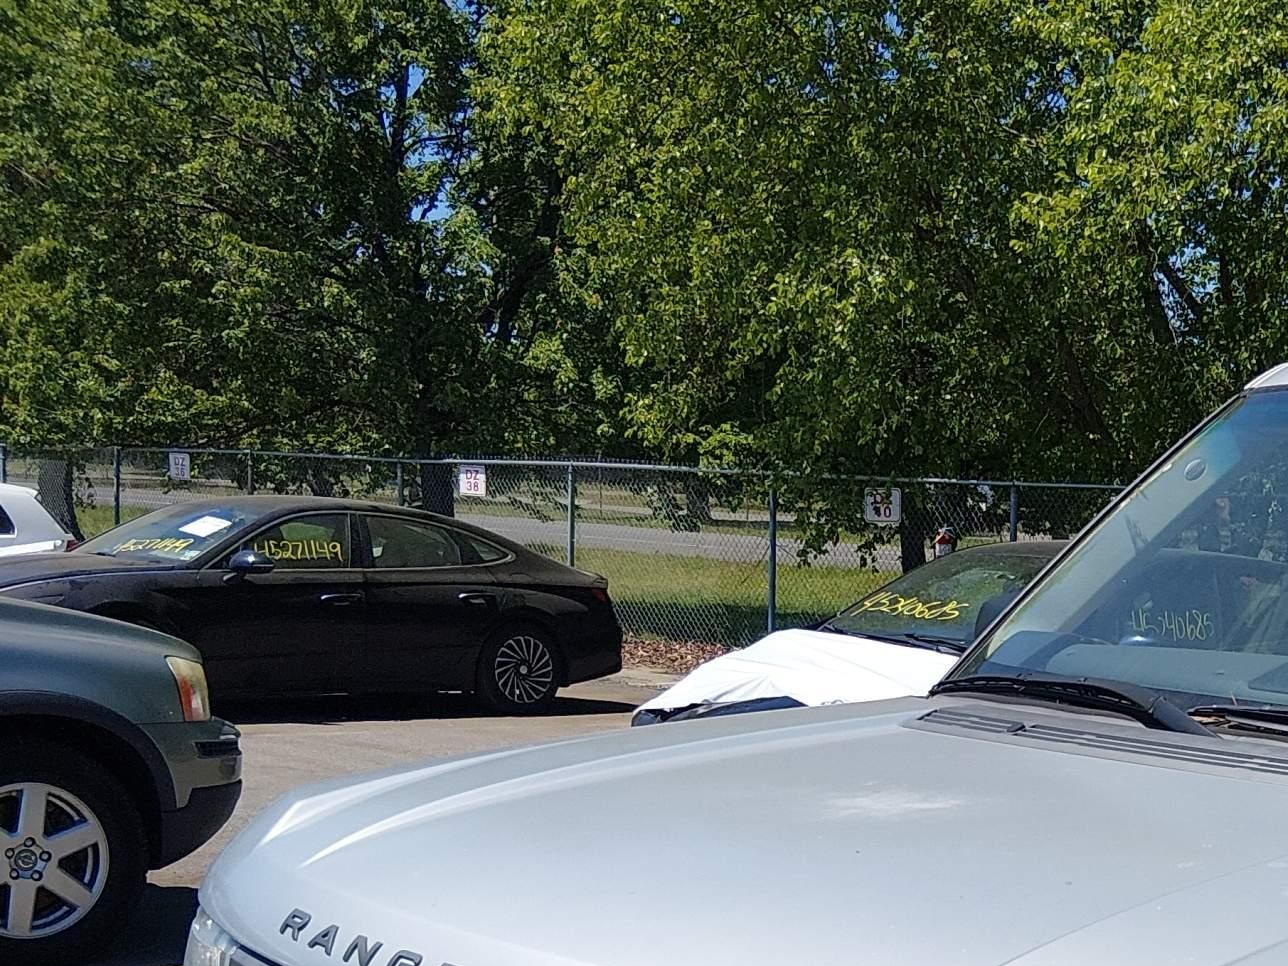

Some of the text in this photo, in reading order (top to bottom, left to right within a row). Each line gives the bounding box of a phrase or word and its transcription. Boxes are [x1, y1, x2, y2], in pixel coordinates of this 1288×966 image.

[465, 469, 480, 481] DZ
[466, 481, 479, 491] 38
[254, 539, 343, 562] 45271149
